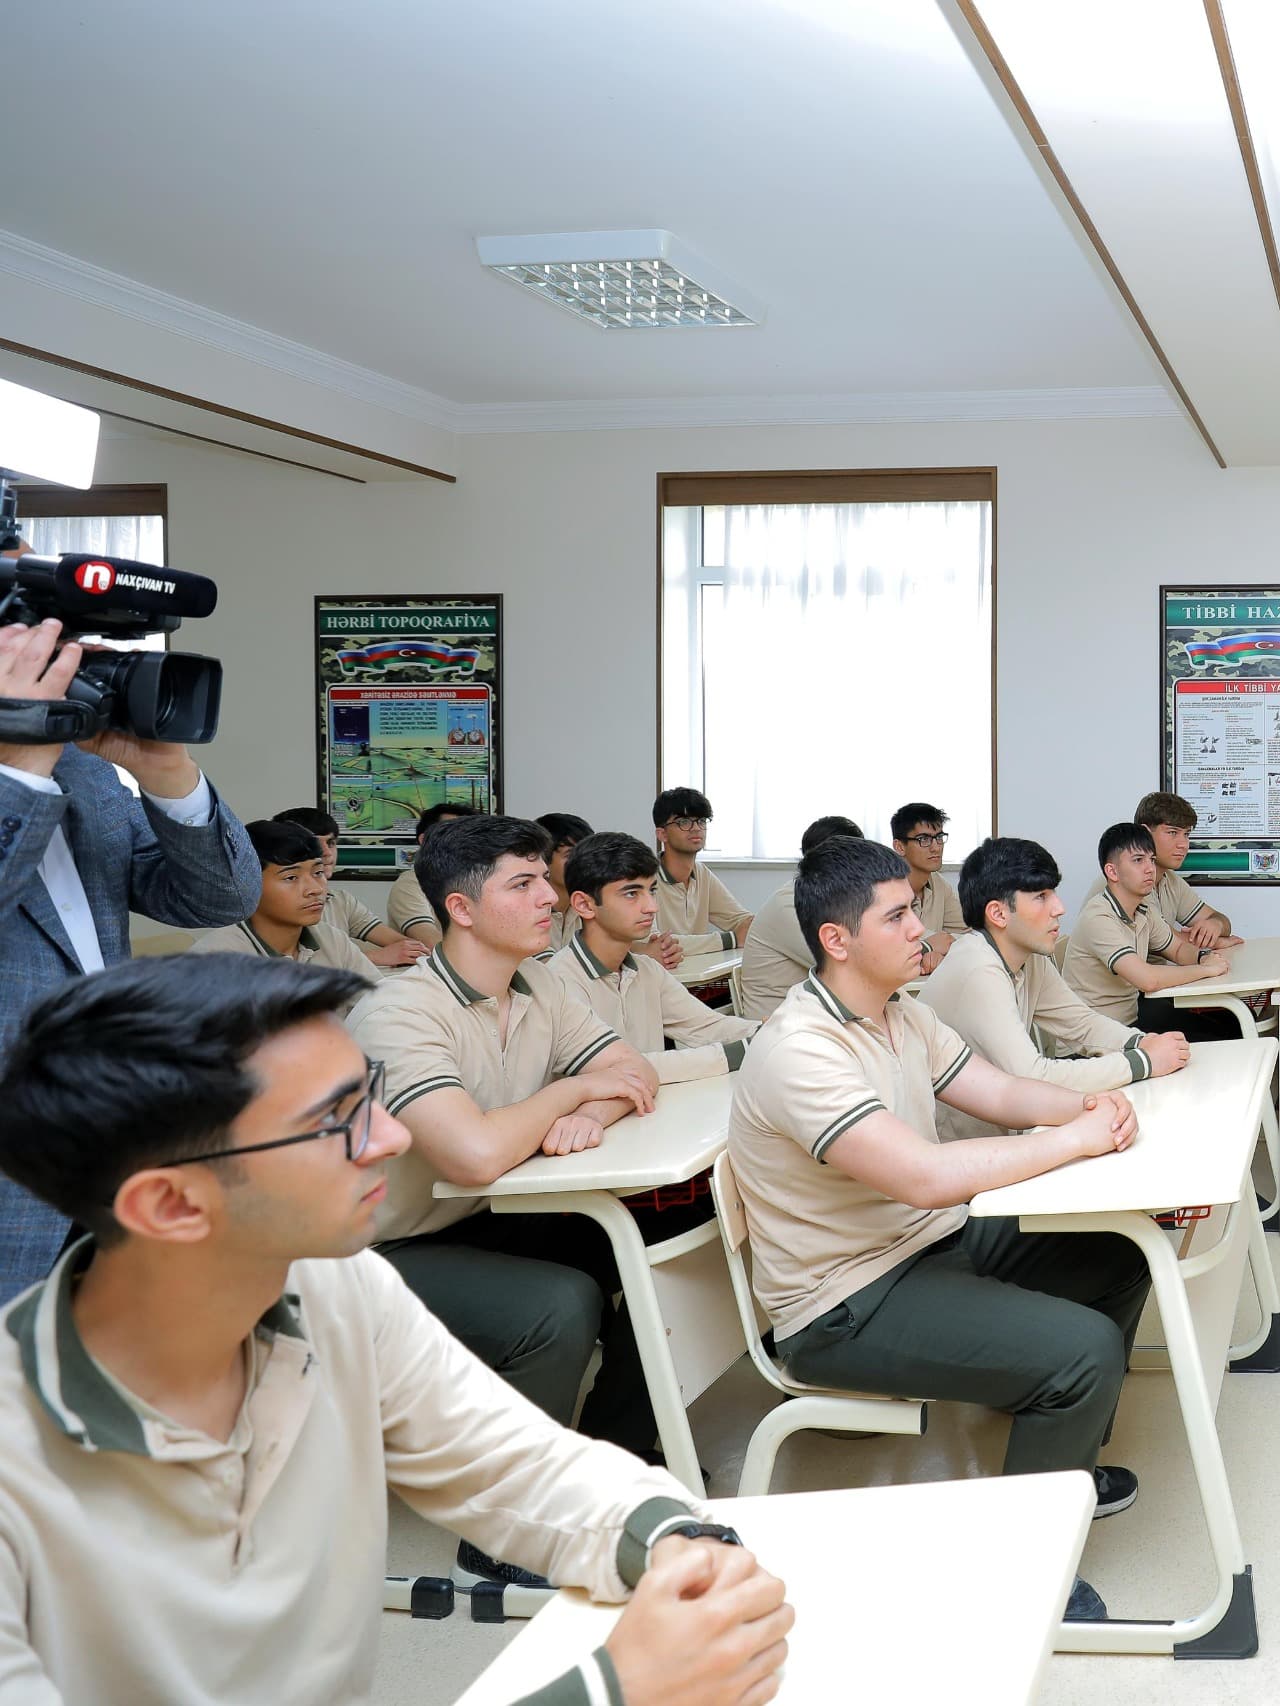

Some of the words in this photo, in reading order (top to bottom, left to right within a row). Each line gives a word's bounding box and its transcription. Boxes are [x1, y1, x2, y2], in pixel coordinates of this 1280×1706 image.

[115, 573, 162, 592] NAXÇIVAN
[163, 581, 176, 594] TV
[1182, 604, 1237, 619] TİBBİ
[327, 614, 375, 629] HƏRBİ
[378, 613, 490, 630] TOPOQRAFİYA
[1225, 682, 1239, 693] İLK
[1243, 682, 1267, 693] TİBBİ
